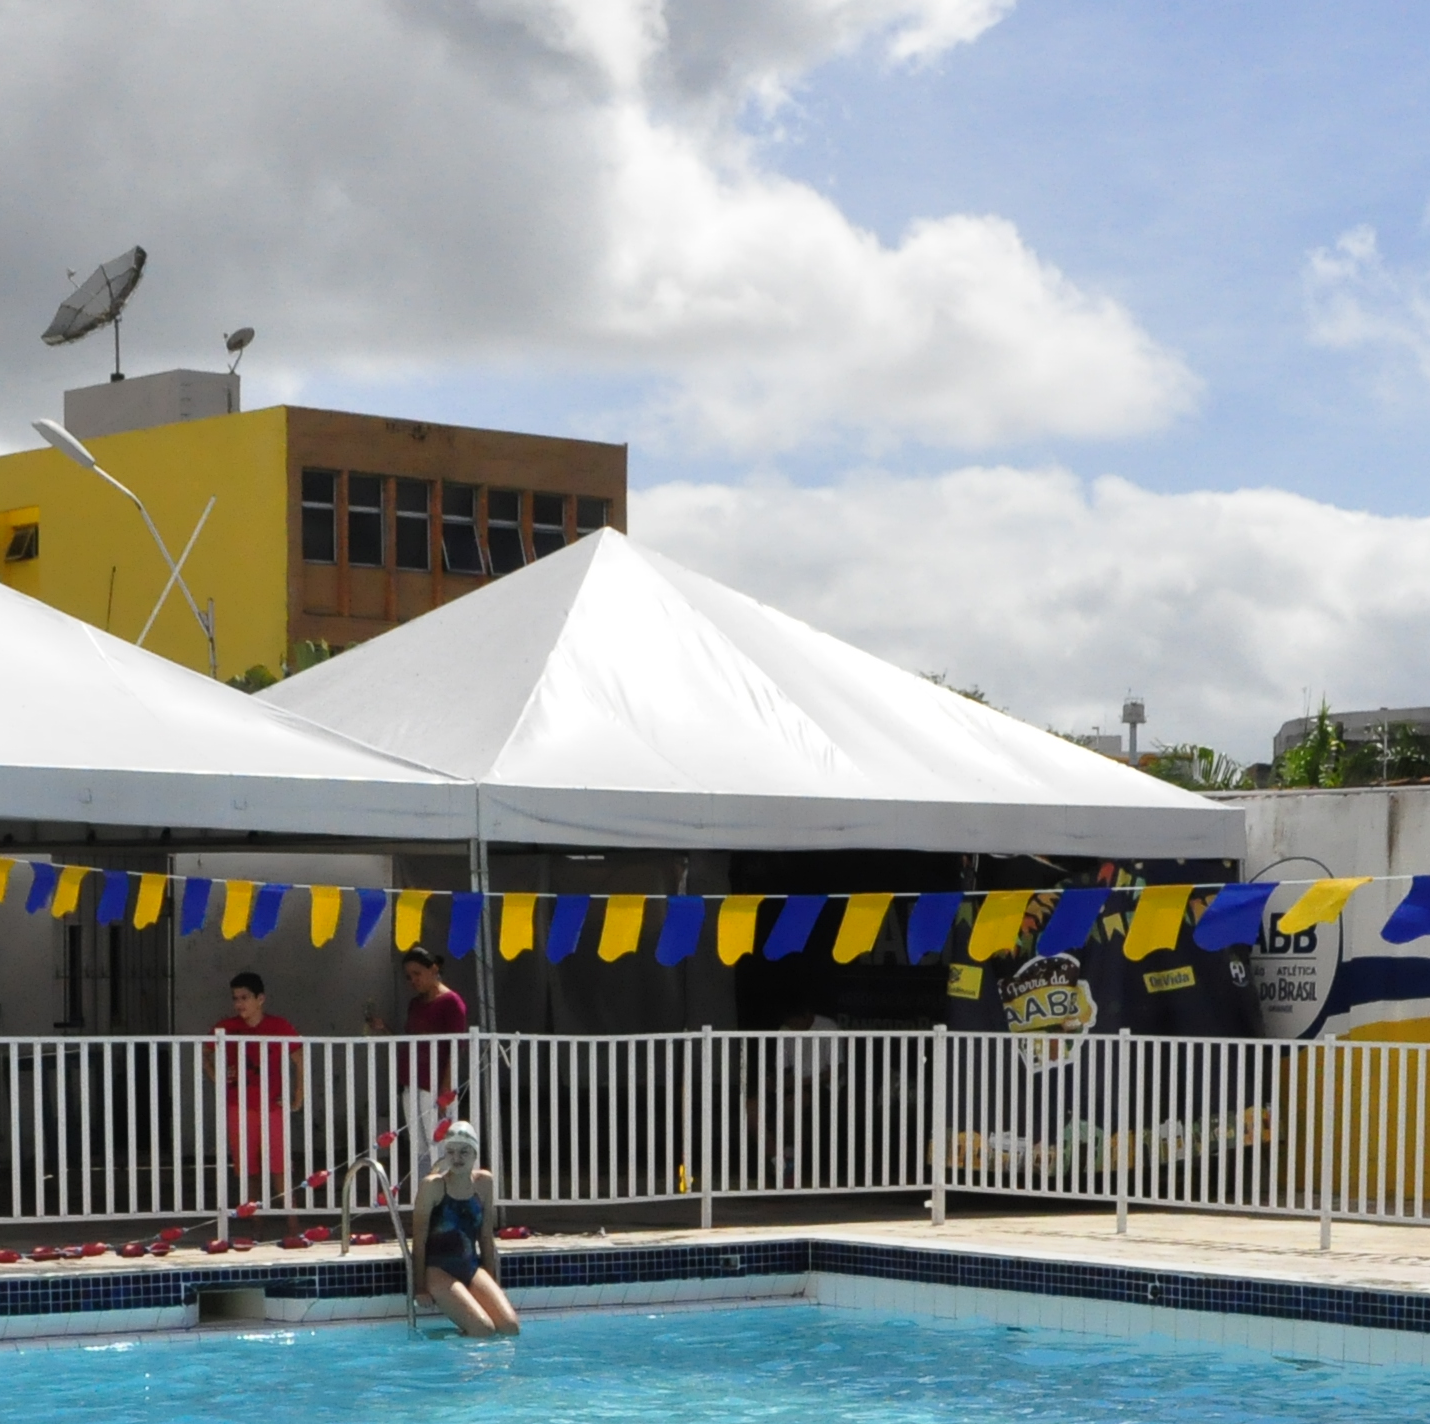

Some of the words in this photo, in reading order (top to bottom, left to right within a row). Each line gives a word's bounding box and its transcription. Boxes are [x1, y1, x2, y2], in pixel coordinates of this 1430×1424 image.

[1276, 964, 1317, 977] ATLÉTICA
[1006, 974, 1049, 997] Forró
[1050, 971, 1070, 986] da
[1259, 982, 1276, 1001] DO
[1278, 978, 1318, 1002] BRASIL
